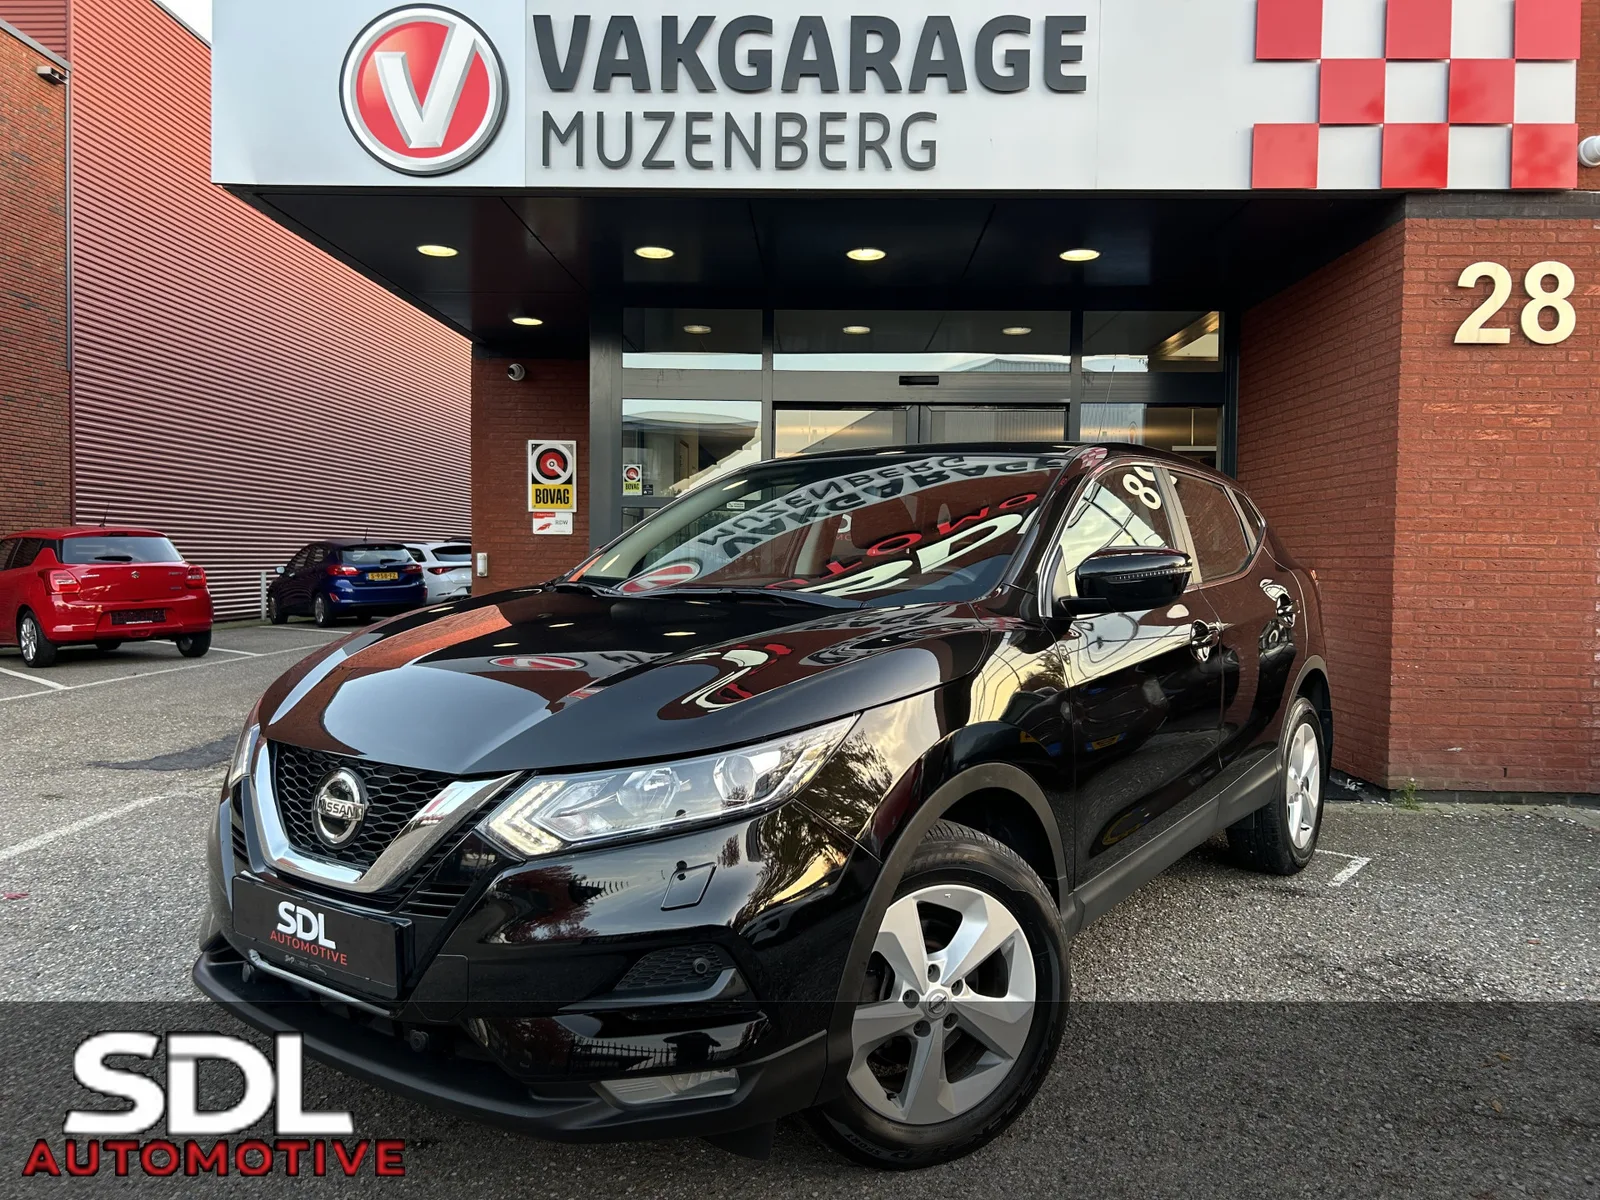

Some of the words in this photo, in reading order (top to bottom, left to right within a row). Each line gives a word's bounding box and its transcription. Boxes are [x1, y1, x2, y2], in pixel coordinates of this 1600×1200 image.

[532, 14, 1088, 94] VAKGARAGE
[541, 111, 938, 171] MUZENBERG
[1454, 260, 1577, 345] 28
[535, 488, 570, 505] BOVAG
[625, 482, 640, 491] BOVAG
[319, 798, 356, 818] NISSAN
[277, 901, 337, 950] SDL
[269, 929, 348, 967] AUTOMOTIVE
